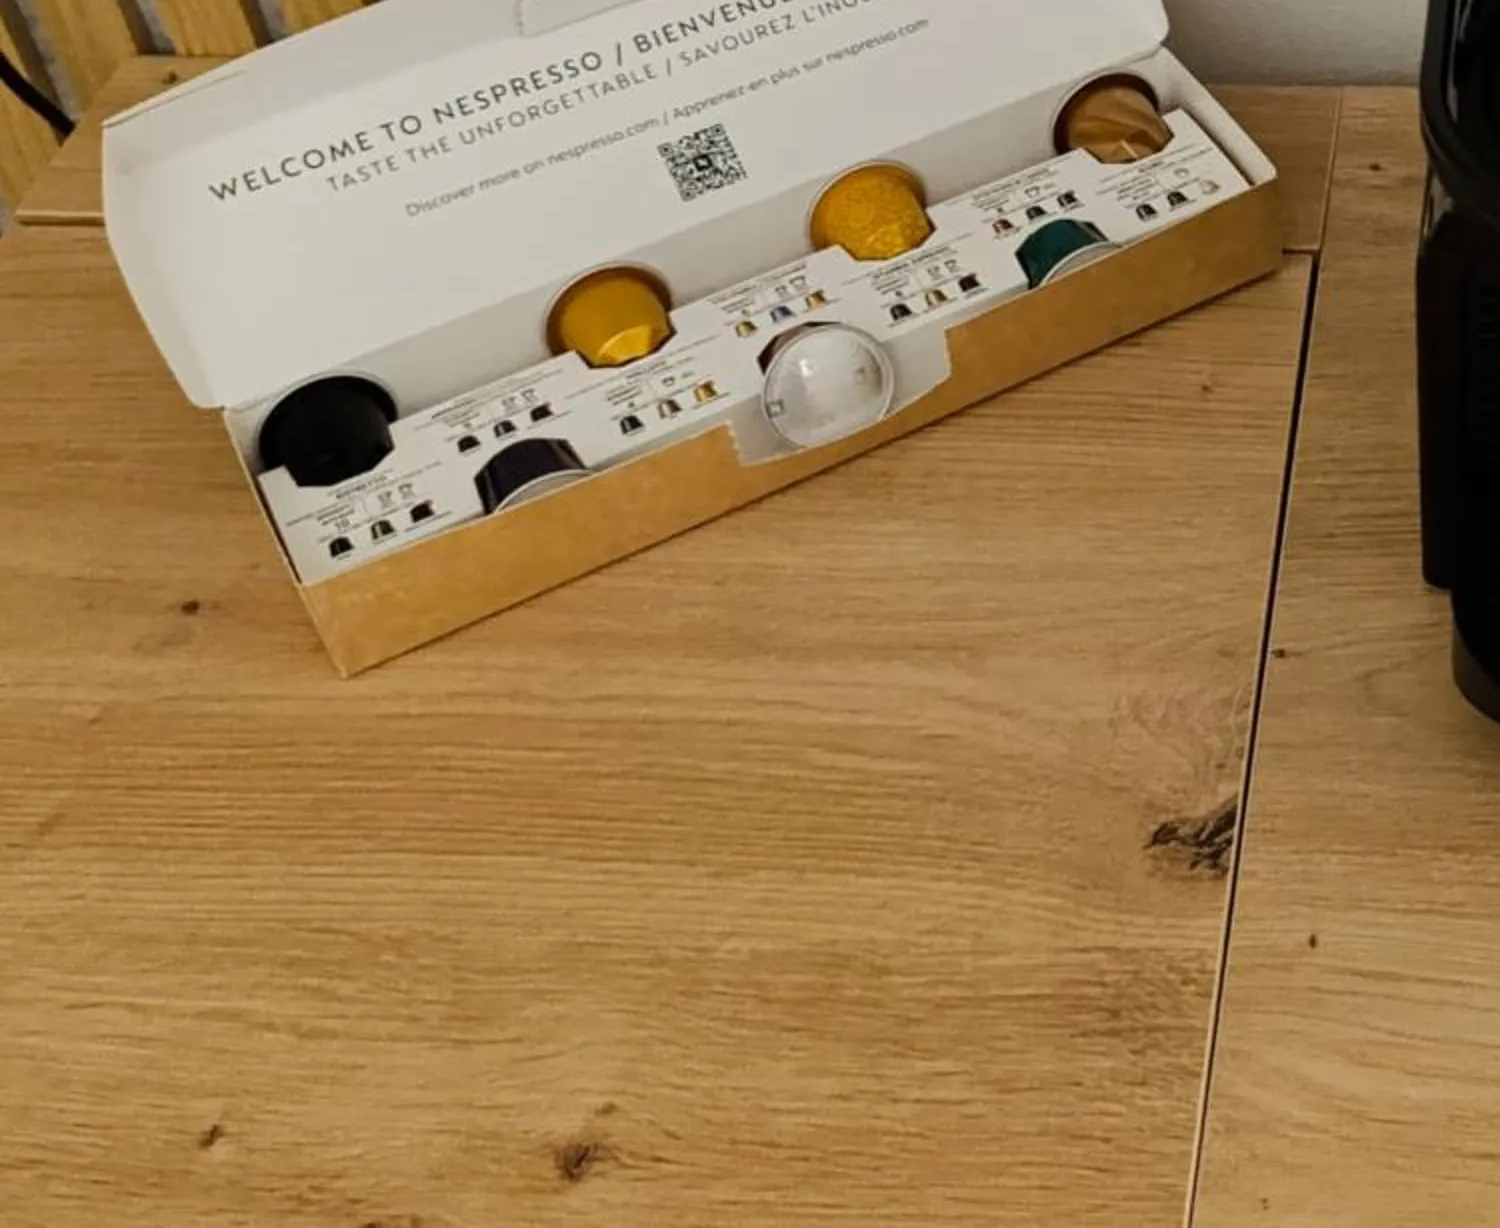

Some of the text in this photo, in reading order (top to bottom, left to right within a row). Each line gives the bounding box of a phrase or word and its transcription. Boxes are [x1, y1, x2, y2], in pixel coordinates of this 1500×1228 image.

[207, 130, 375, 202] WELCOME
[377, 114, 423, 143] TO
[431, 51, 603, 126] NESPRESSO
[614, 40, 623, 67] /
[324, 154, 401, 193] TASTE
[402, 135, 454, 164] THE
[457, 62, 659, 146] UNFORGETTABLE
[665, 56, 673, 78] /
[676, 12, 797, 68] SAVOUREZ
[404, 183, 476, 218] Discover
[477, 167, 522, 191] more
[521, 159, 546, 176] on
[545, 117, 661, 166] nespresso.com
[769, 65, 802, 87] plus
[824, 19, 930, 64] nespresso.com
